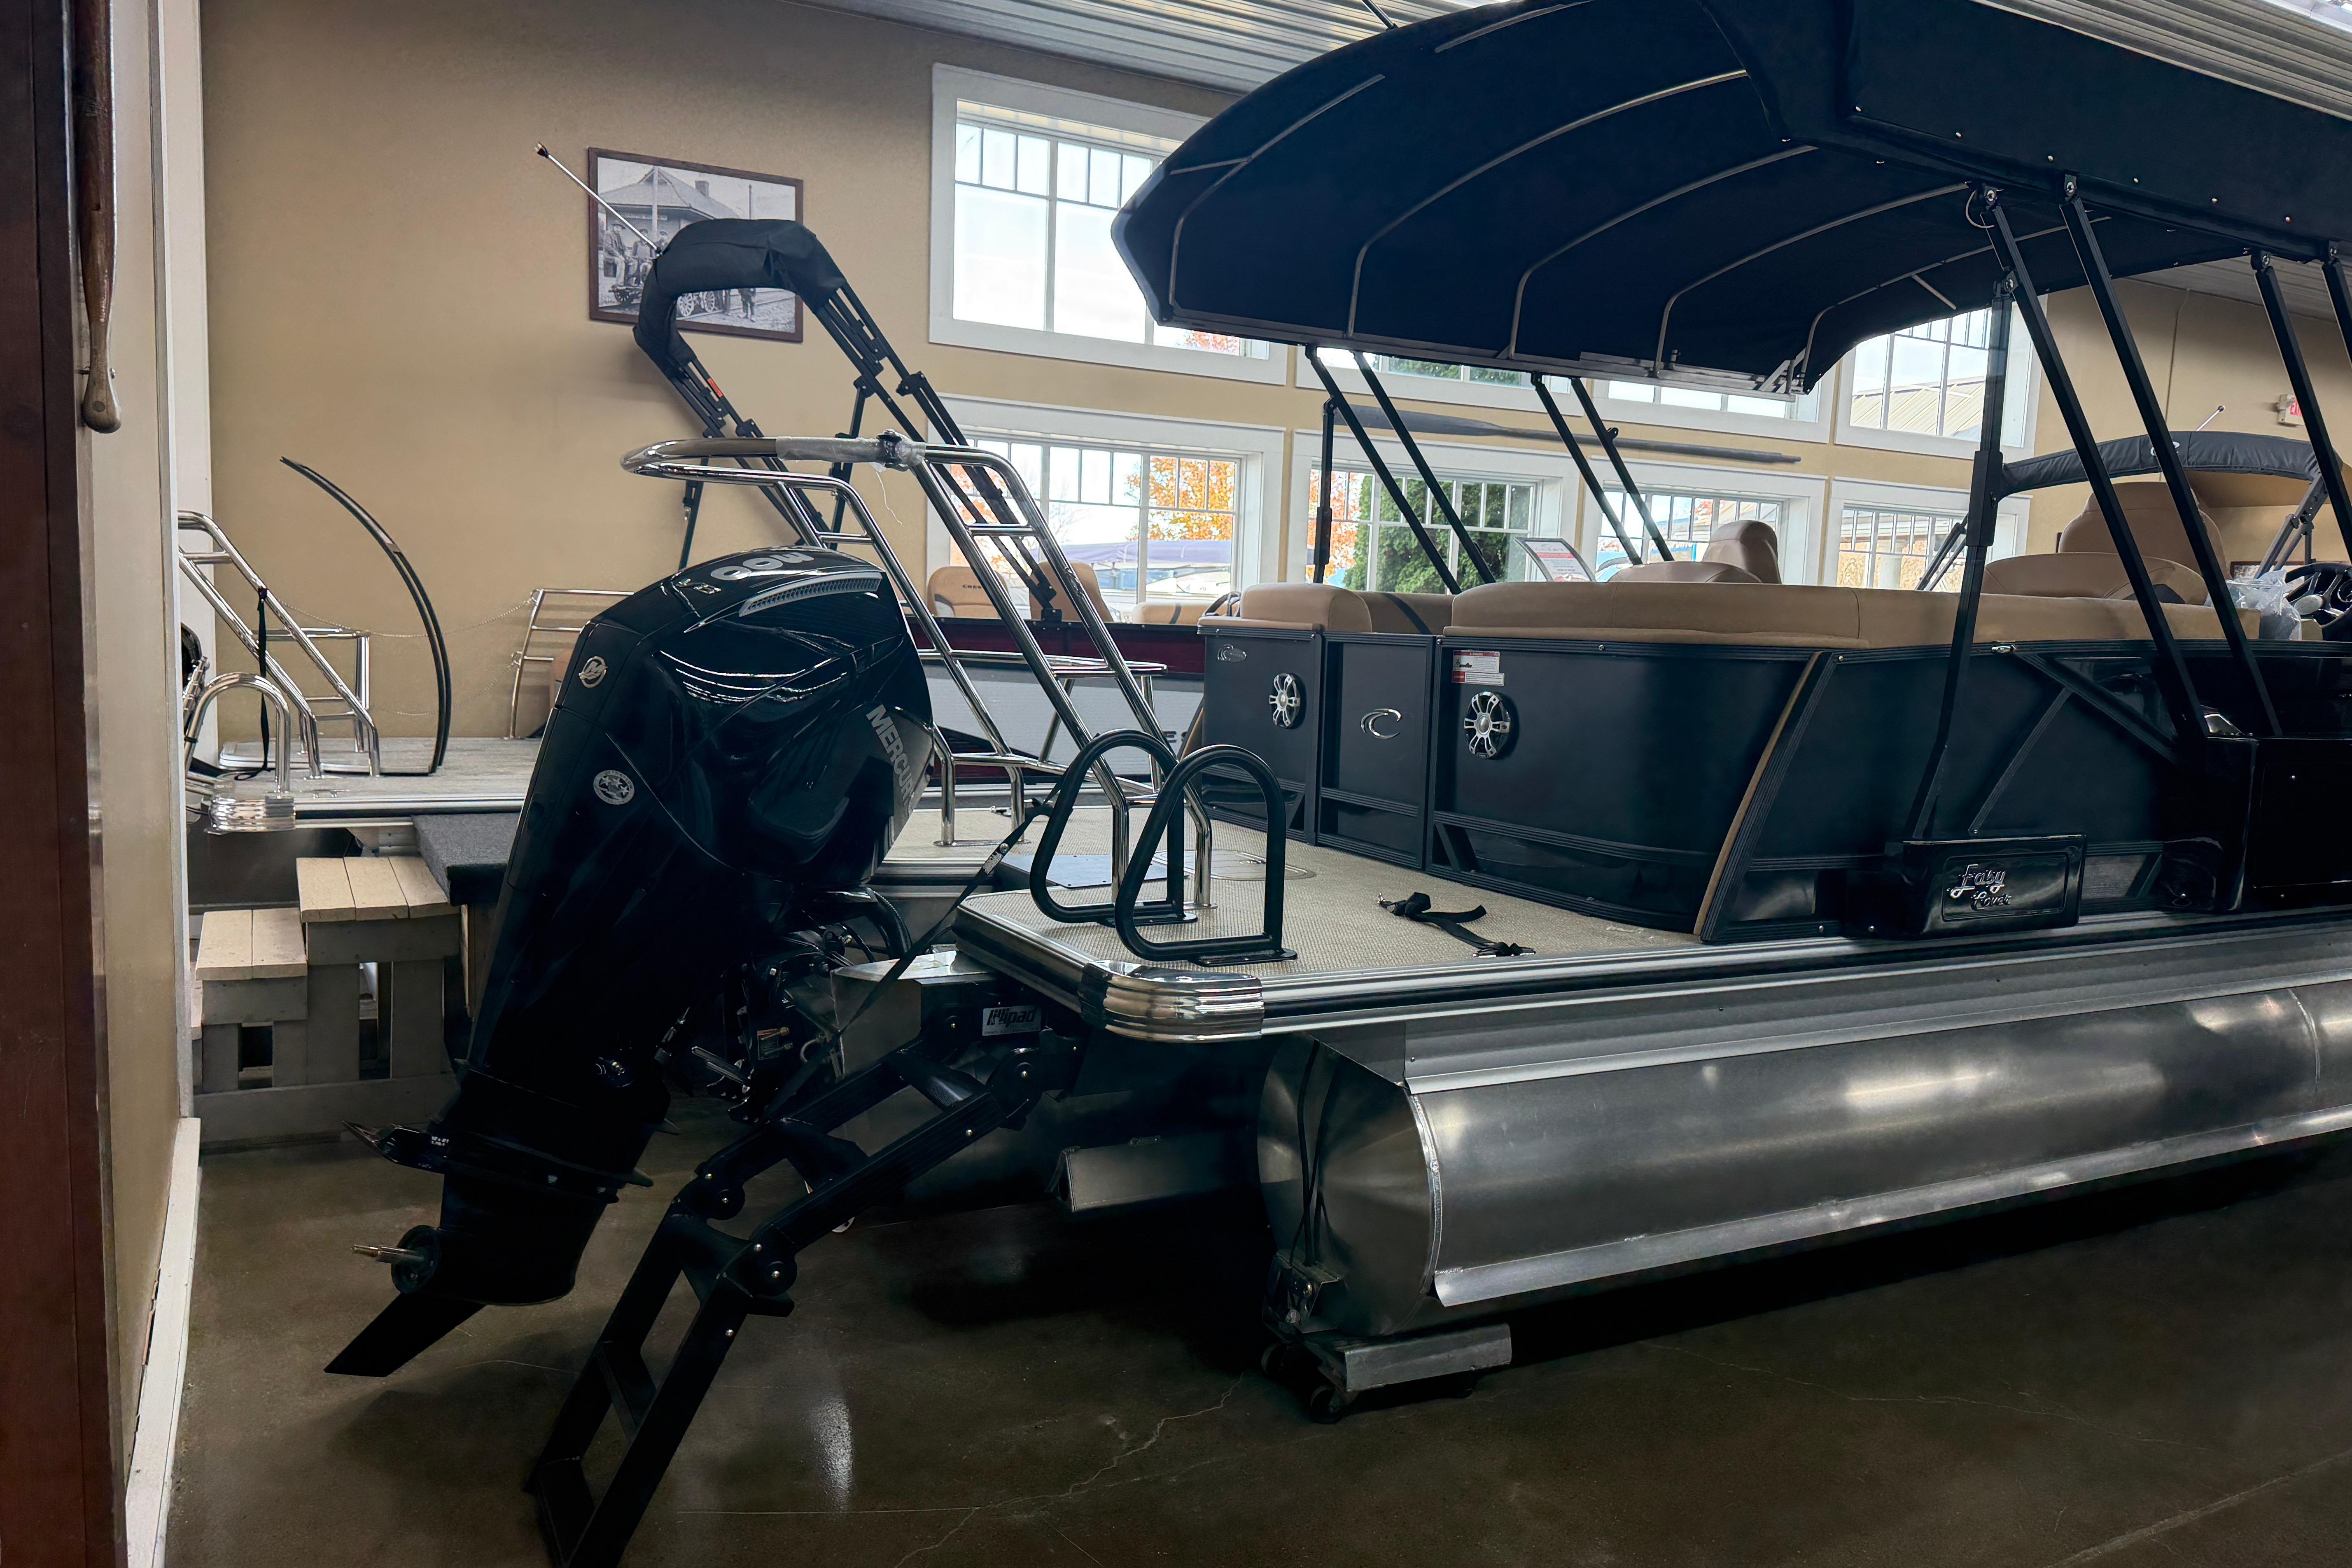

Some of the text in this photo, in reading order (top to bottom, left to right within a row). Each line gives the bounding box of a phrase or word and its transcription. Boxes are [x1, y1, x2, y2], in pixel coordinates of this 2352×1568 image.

[710, 552, 814, 581] 300
[866, 704, 913, 804] MERCUR
[1950, 863, 2006, 898] Easy
